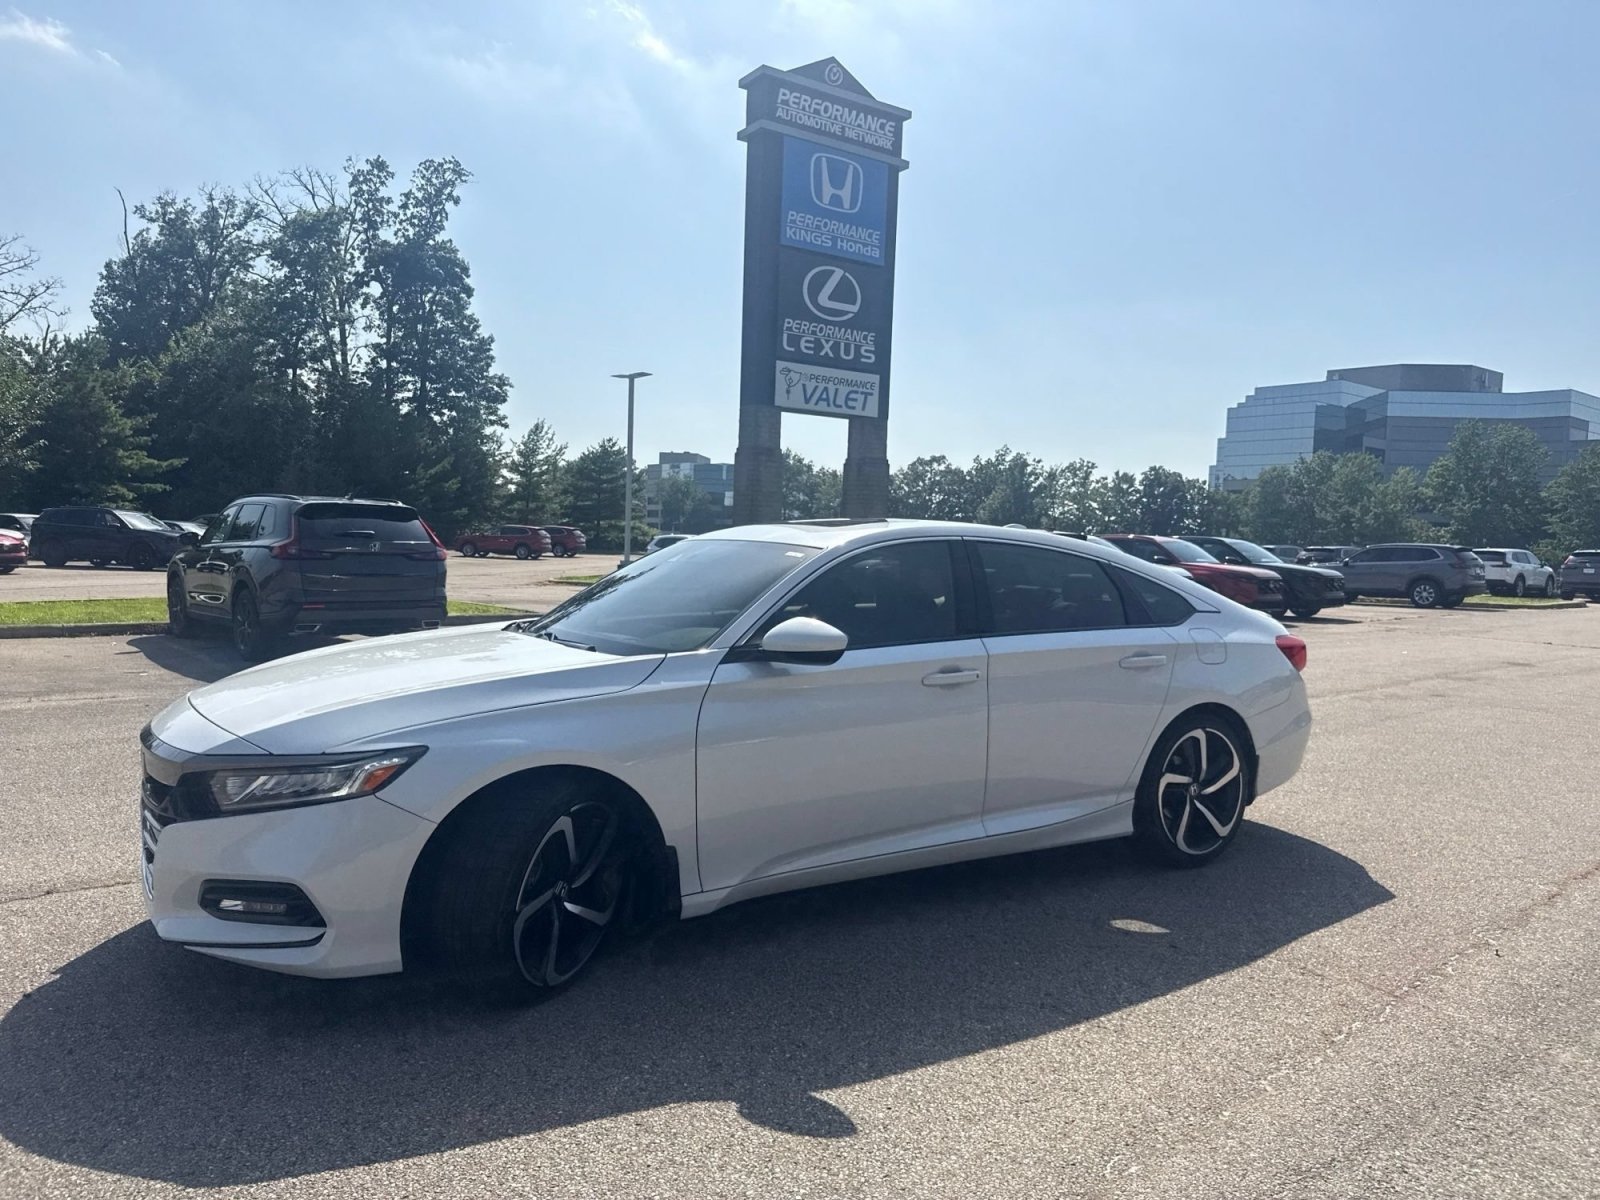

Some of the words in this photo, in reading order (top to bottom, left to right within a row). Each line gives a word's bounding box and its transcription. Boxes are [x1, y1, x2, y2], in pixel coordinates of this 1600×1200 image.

[778, 88, 895, 137] PERFORMANCE
[776, 107, 842, 136] AUTOMOTIVE
[845, 127, 893, 151] NETWORK
[787, 211, 880, 244] PERFORMANCE
[786, 228, 832, 247] KINGS
[837, 238, 880, 258] Honda
[783, 318, 875, 345] PERFORMANCE
[782, 333, 875, 364] LEXUS
[808, 373, 876, 391] PERFORMANCE
[802, 383, 874, 412] VALET
